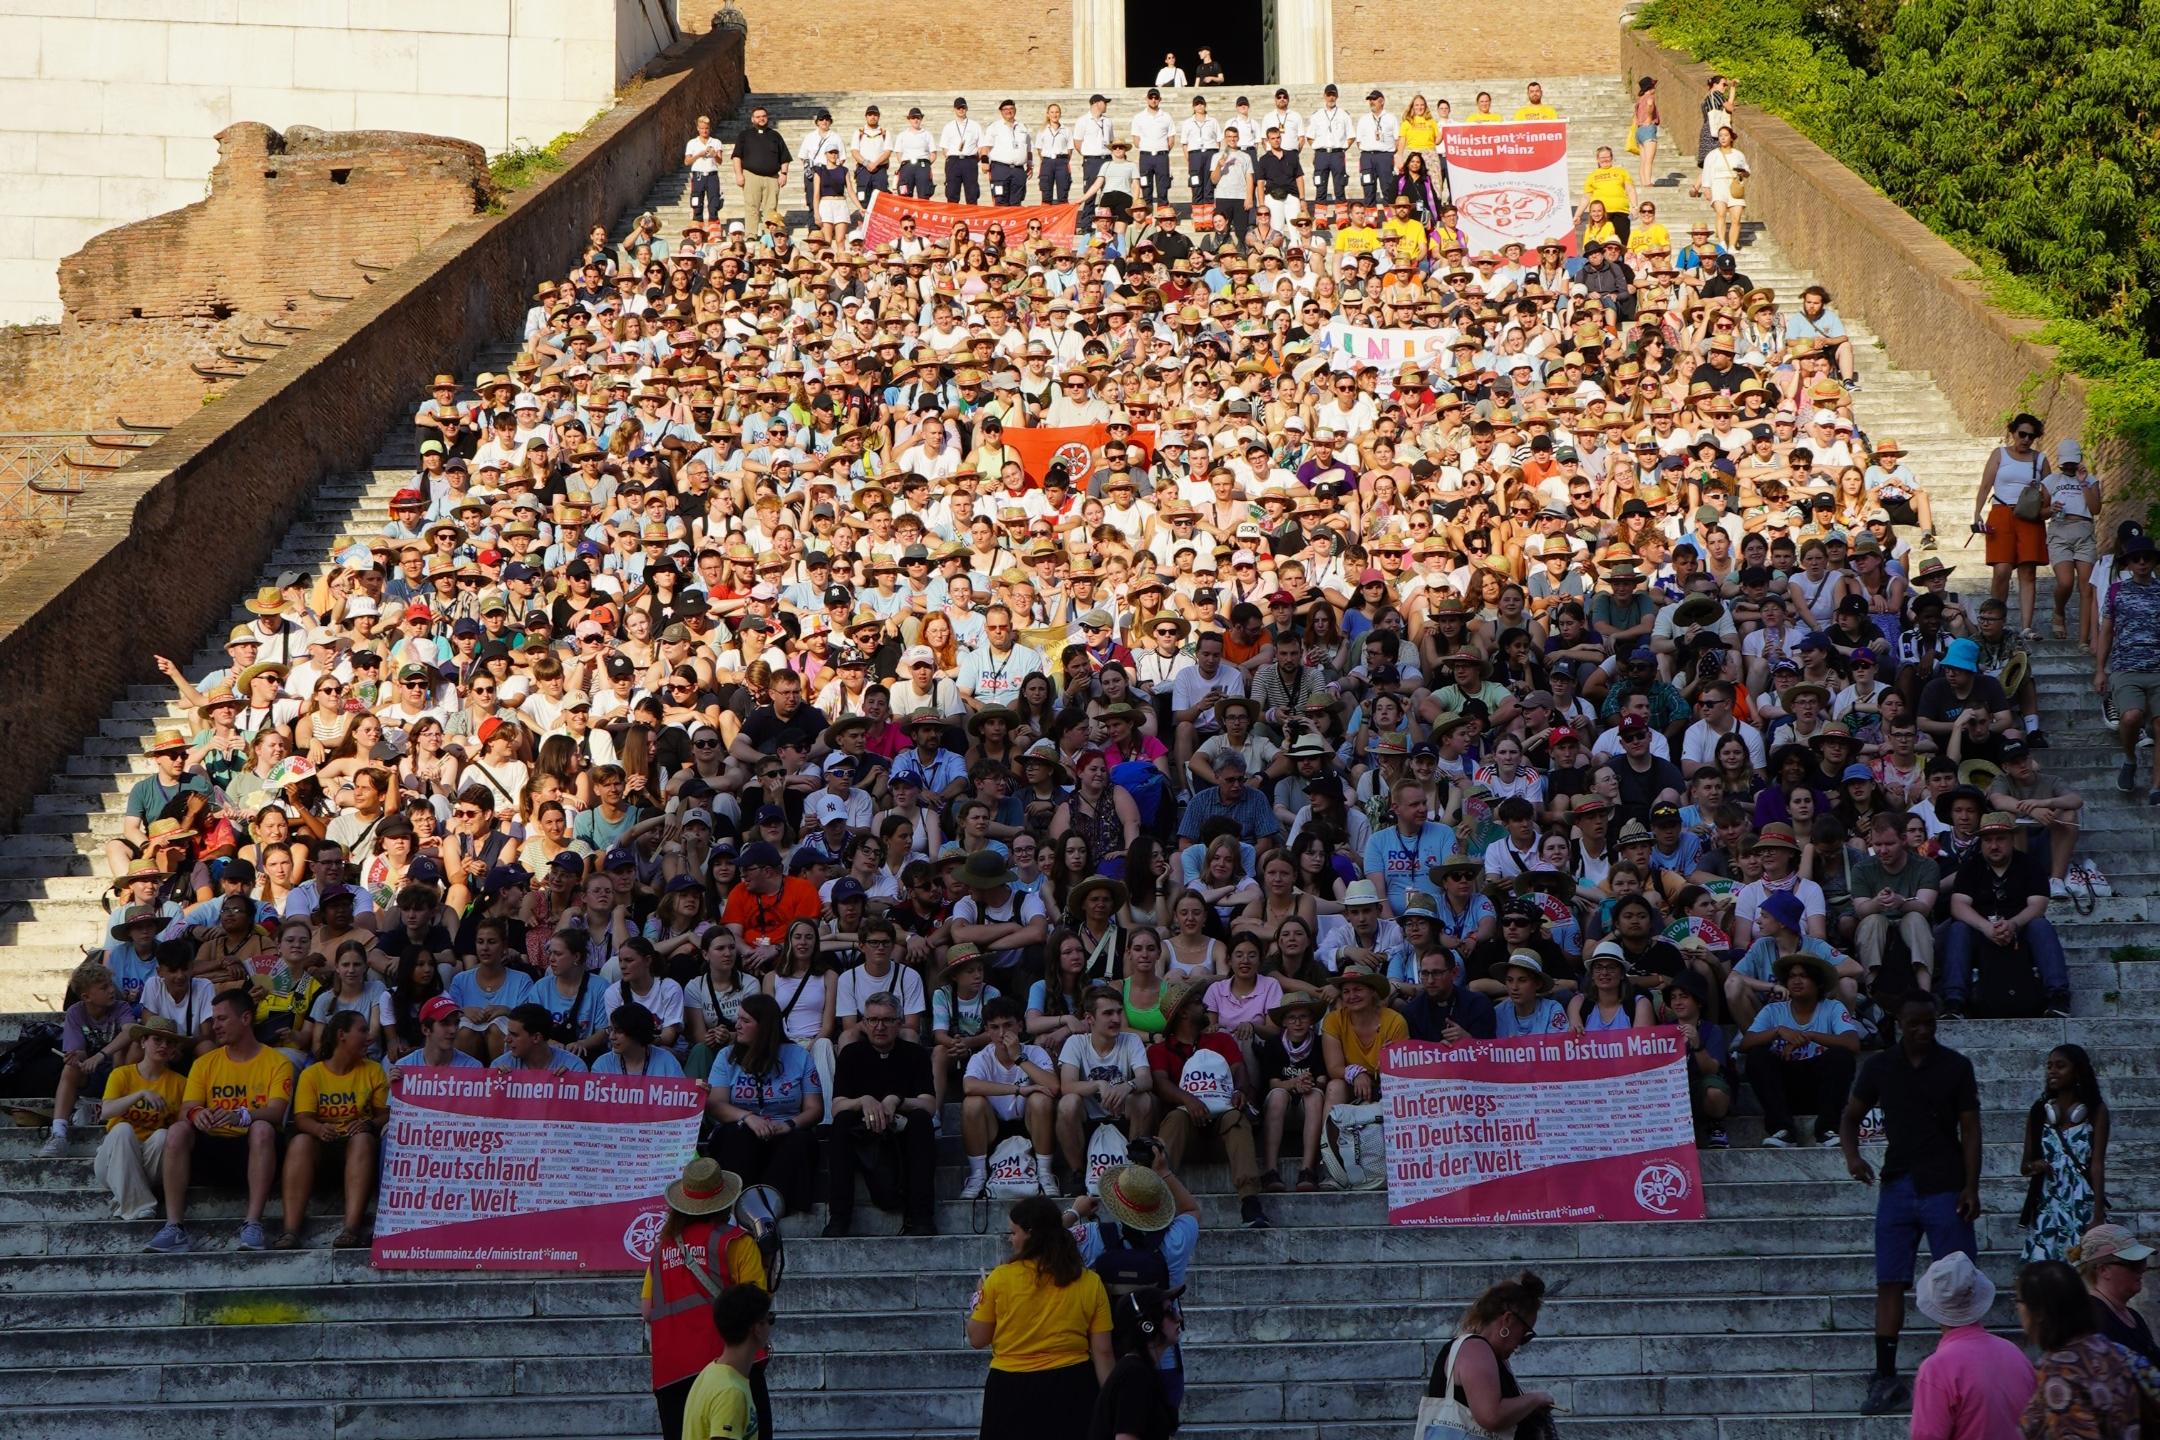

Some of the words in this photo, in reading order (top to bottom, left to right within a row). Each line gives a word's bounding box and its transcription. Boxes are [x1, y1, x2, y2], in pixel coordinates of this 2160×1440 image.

[1448, 146, 1493, 157] Bistum
[1496, 145, 1535, 156] Mainz
[982, 671, 1007, 680] ROM
[982, 680, 1008, 689] 2024
[826, 802, 836, 812] NY
[1388, 860, 1420, 871] 2024
[1547, 900, 1566, 918] 2024
[1672, 921, 1689, 938] ROM
[1700, 922, 1721, 943] 2024
[1540, 1040, 1560, 1062] im
[1565, 1036, 1624, 1061] Bistum
[1628, 1034, 1677, 1057] Mainz
[212, 1085, 248, 1098] ROM
[319, 1092, 356, 1105] ROM
[558, 1077, 578, 1099] im
[584, 1078, 644, 1105] Bistum
[649, 1083, 698, 1108] Mainz
[319, 1104, 359, 1118] 2024
[1393, 1092, 1498, 1119] Unterwegs
[1860, 1117, 1885, 1128] OM
[396, 1121, 506, 1155] Unterwegs
[1395, 1125, 1414, 1149] in
[1418, 1117, 1537, 1148] Deutschland
[392, 1153, 412, 1178] in
[417, 1155, 540, 1182] Deutschland
[1090, 1153, 1124, 1168] ROM
[1397, 1157, 1434, 1181] und
[1438, 1154, 1473, 1178] der
[1476, 1149, 1523, 1174] Welt
[389, 1186, 427, 1211] und
[431, 1187, 466, 1211] der
[471, 1187, 518, 1213] Welt
